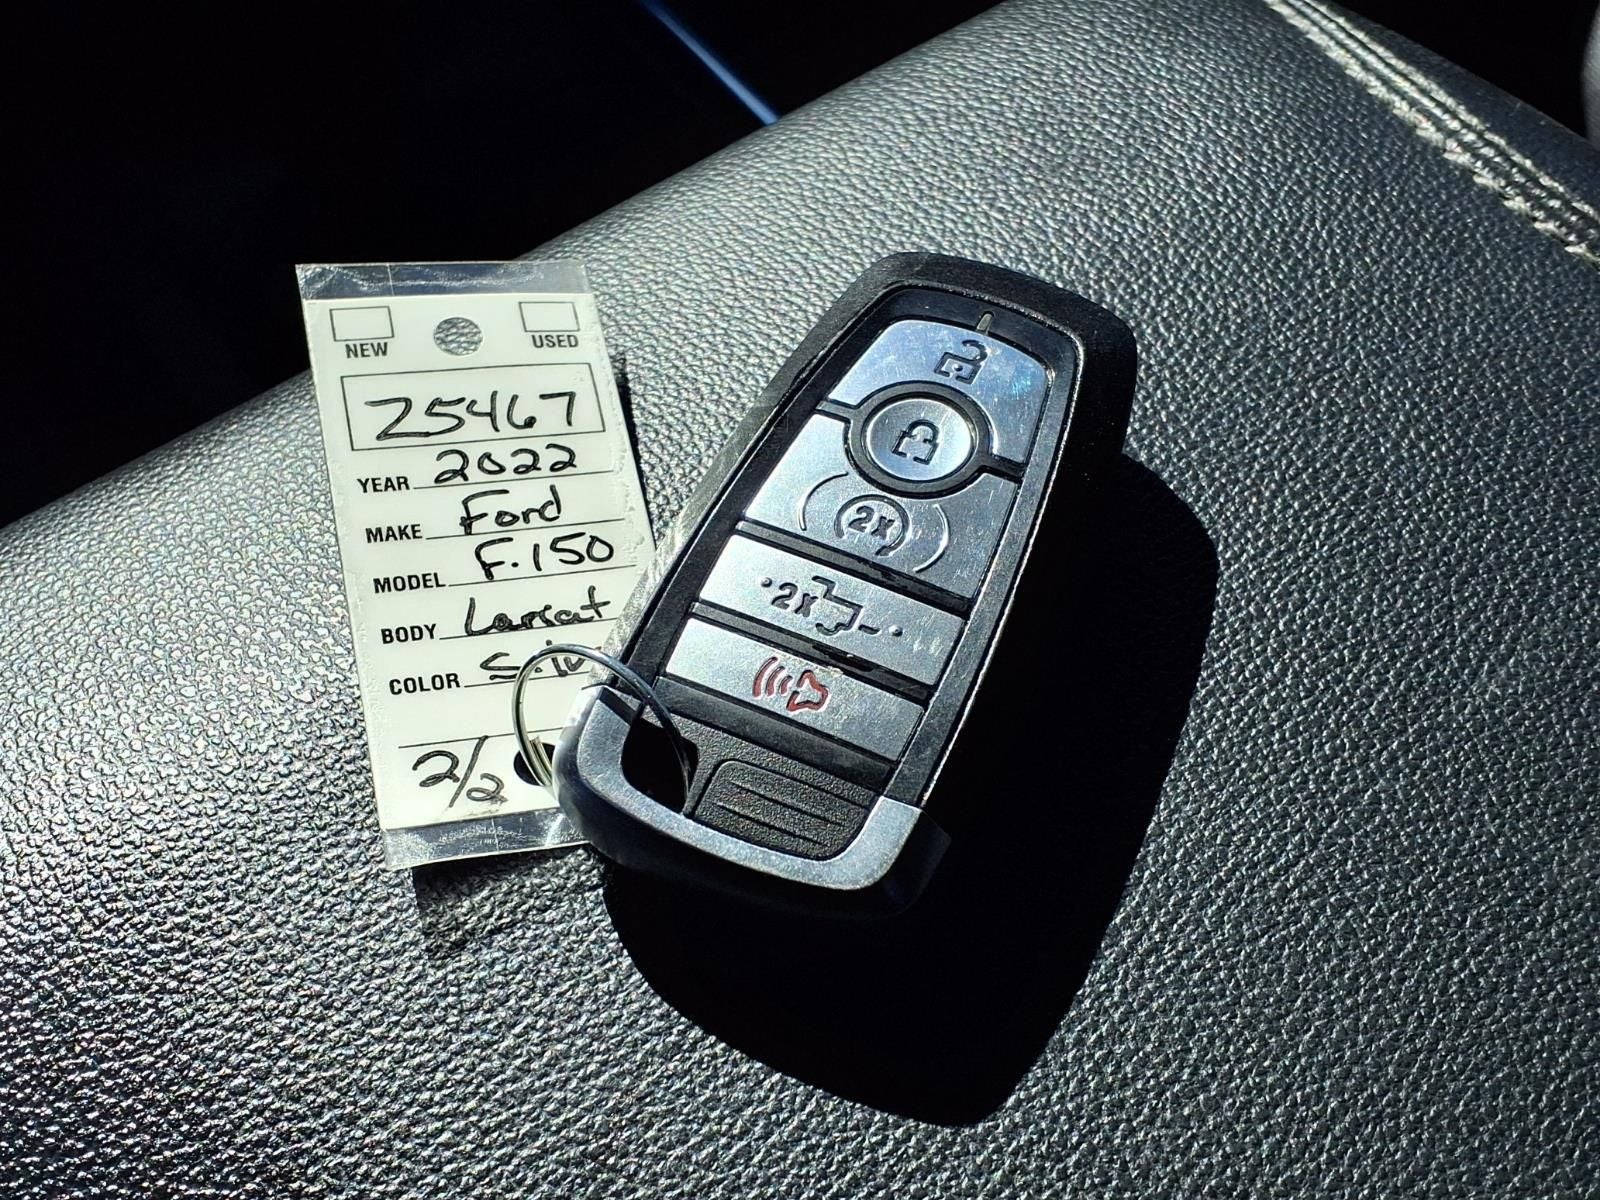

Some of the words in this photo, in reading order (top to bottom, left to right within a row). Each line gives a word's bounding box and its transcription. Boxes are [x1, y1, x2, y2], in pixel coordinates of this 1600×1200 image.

[345, 341, 389, 358] NEW
[531, 334, 579, 349] USED
[433, 443, 577, 484] 2022
[356, 476, 410, 493] YEAR
[459, 484, 562, 536] Ford
[365, 524, 423, 543] MAKE
[373, 572, 447, 594] MODEL
[381, 623, 438, 644] BODY
[388, 673, 461, 695] COLOR
[412, 735, 508, 808] 2/2
